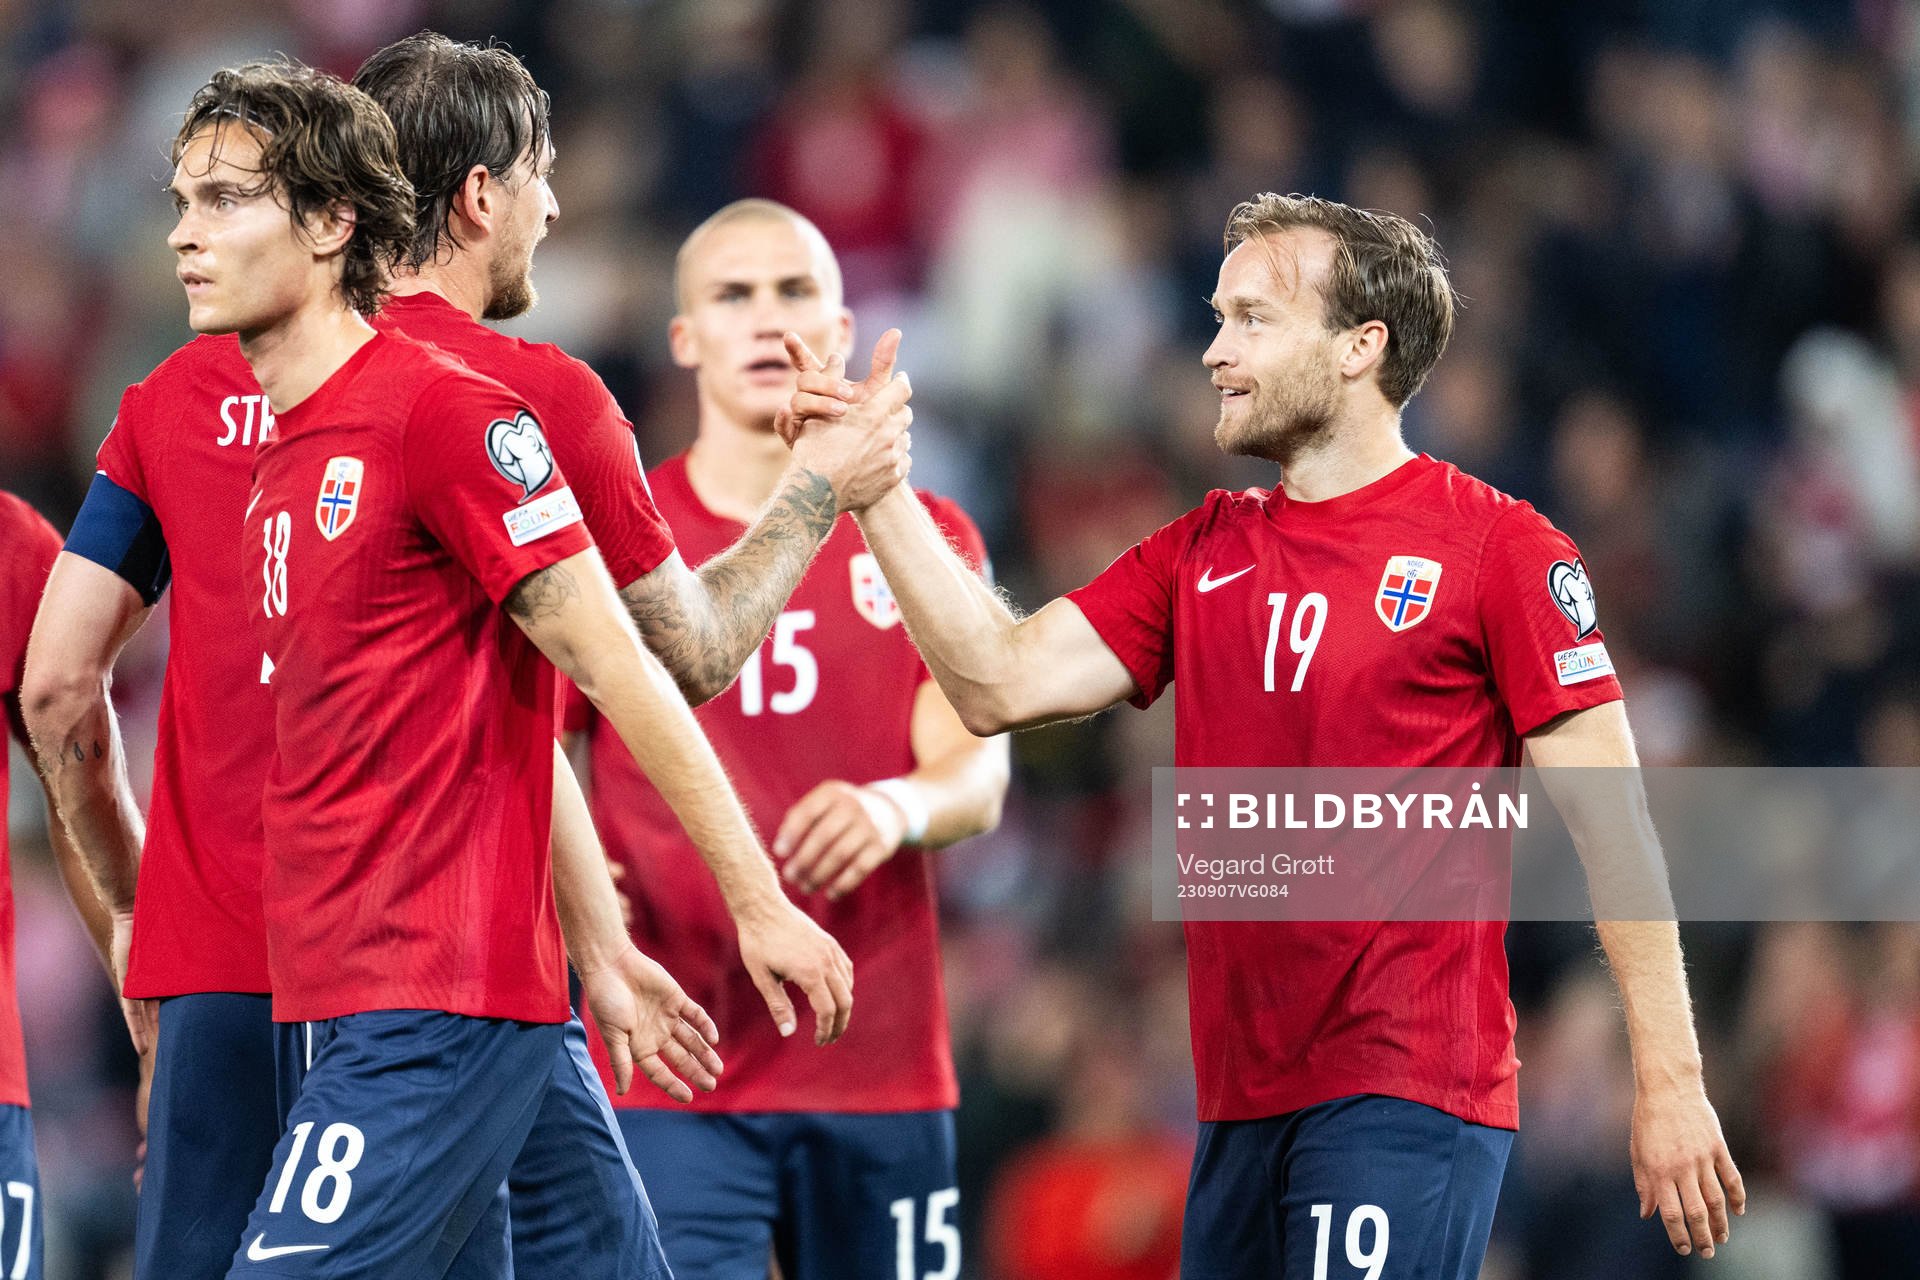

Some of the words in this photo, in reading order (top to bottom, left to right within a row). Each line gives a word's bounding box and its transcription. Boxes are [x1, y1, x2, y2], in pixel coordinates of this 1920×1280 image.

[262, 510, 292, 618] 18
[739, 609, 818, 716] 15
[1264, 592, 1329, 692] 19
[1557, 650, 1578, 662] UEFA
[268, 1121, 365, 1224] 18
[890, 1187, 961, 1280] 15
[1310, 1204, 1390, 1280] 19
